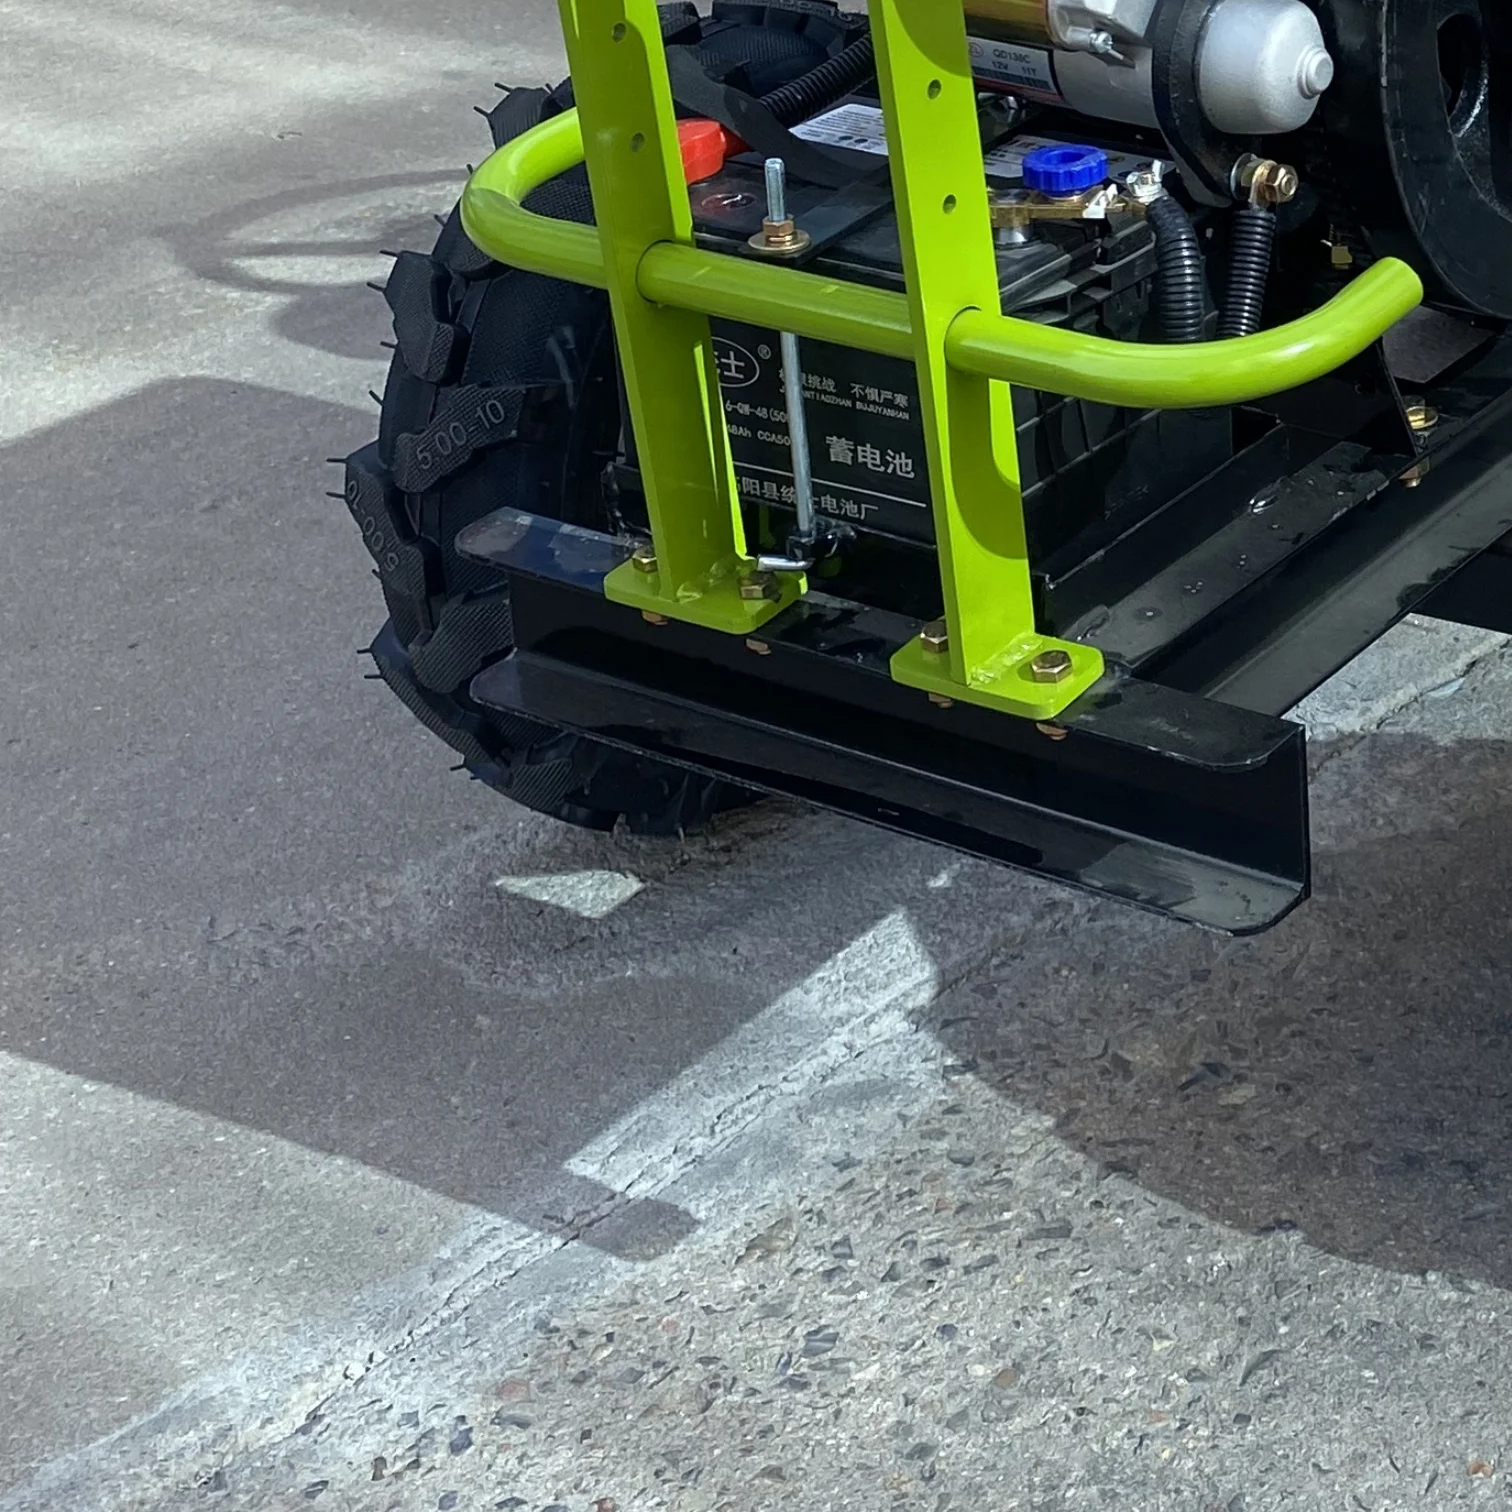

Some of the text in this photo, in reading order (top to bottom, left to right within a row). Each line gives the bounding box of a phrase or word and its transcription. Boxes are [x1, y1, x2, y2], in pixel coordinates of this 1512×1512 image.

[725, 399, 789, 424] 6-QW-48(50
[850, 383, 909, 408] 不惧严寒
[416, 399, 505, 470] 5.00-10
[757, 430, 791, 447] CCA50
[825, 435, 915, 479] 蓄电池
[736, 476, 879, 521] 阳县统电池厂
